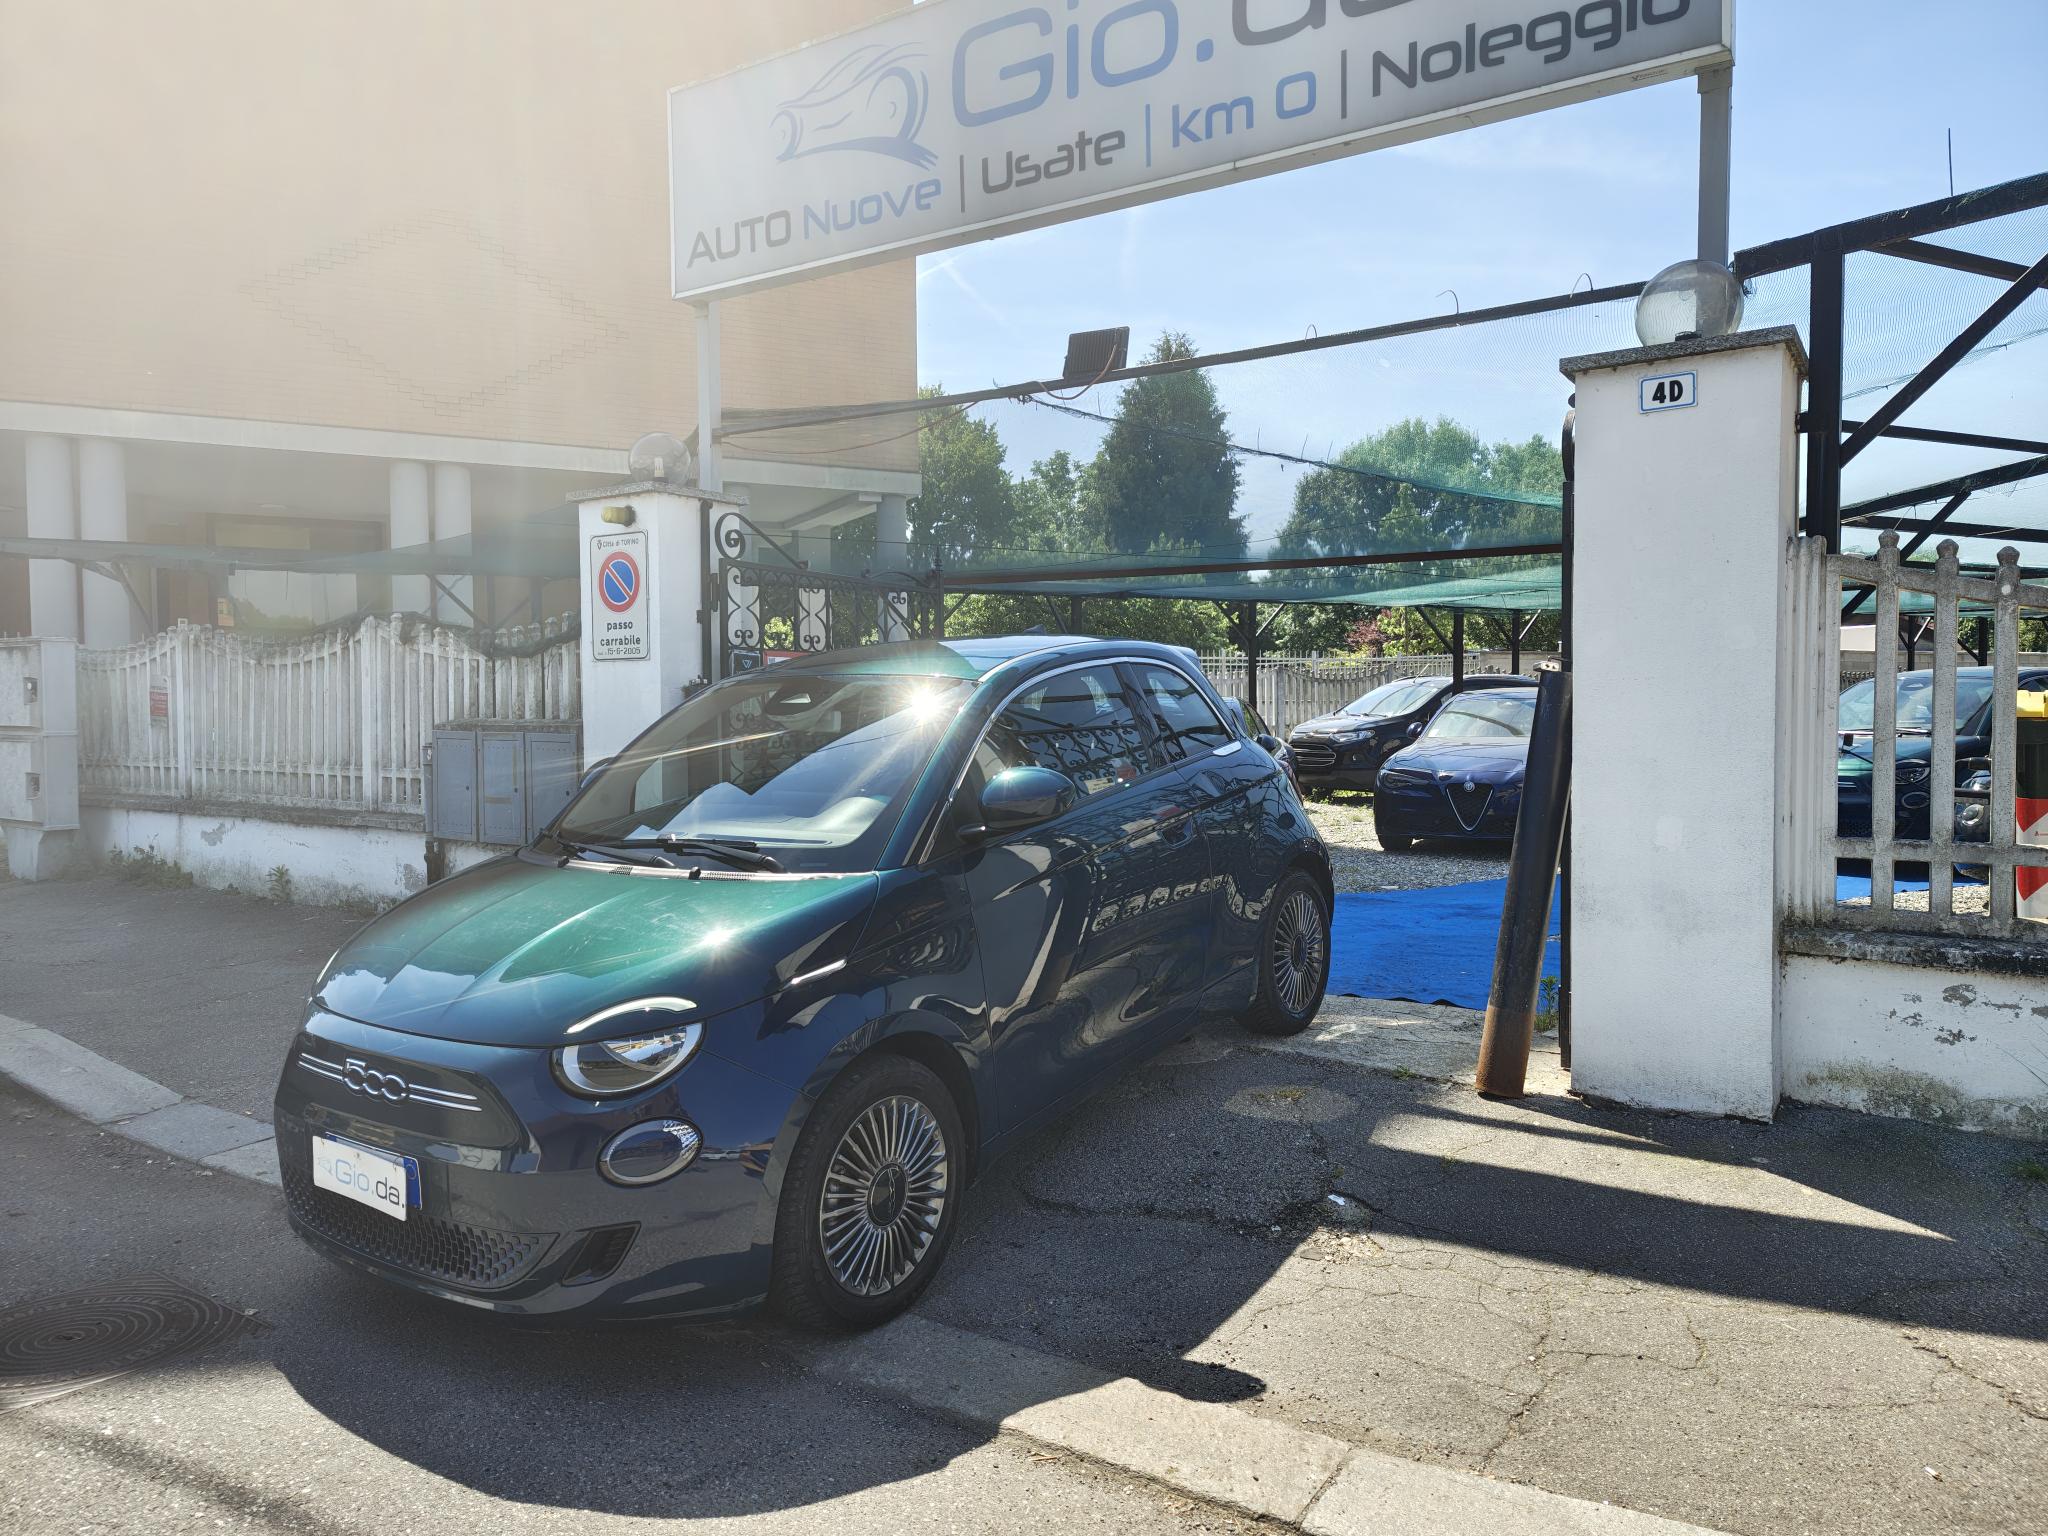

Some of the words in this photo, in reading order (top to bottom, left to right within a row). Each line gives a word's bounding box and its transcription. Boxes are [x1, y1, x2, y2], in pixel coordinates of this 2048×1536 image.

[686, 209, 792, 269] AUTO
[981, 129, 1126, 195] Usate
[1171, 95, 1254, 149] km
[1372, 0, 1691, 97] Noleggio
[1652, 380, 1683, 403] 4D
[607, 621, 633, 632] passo
[600, 634, 641, 646] carrabile
[345, 1058, 407, 1100] 500
